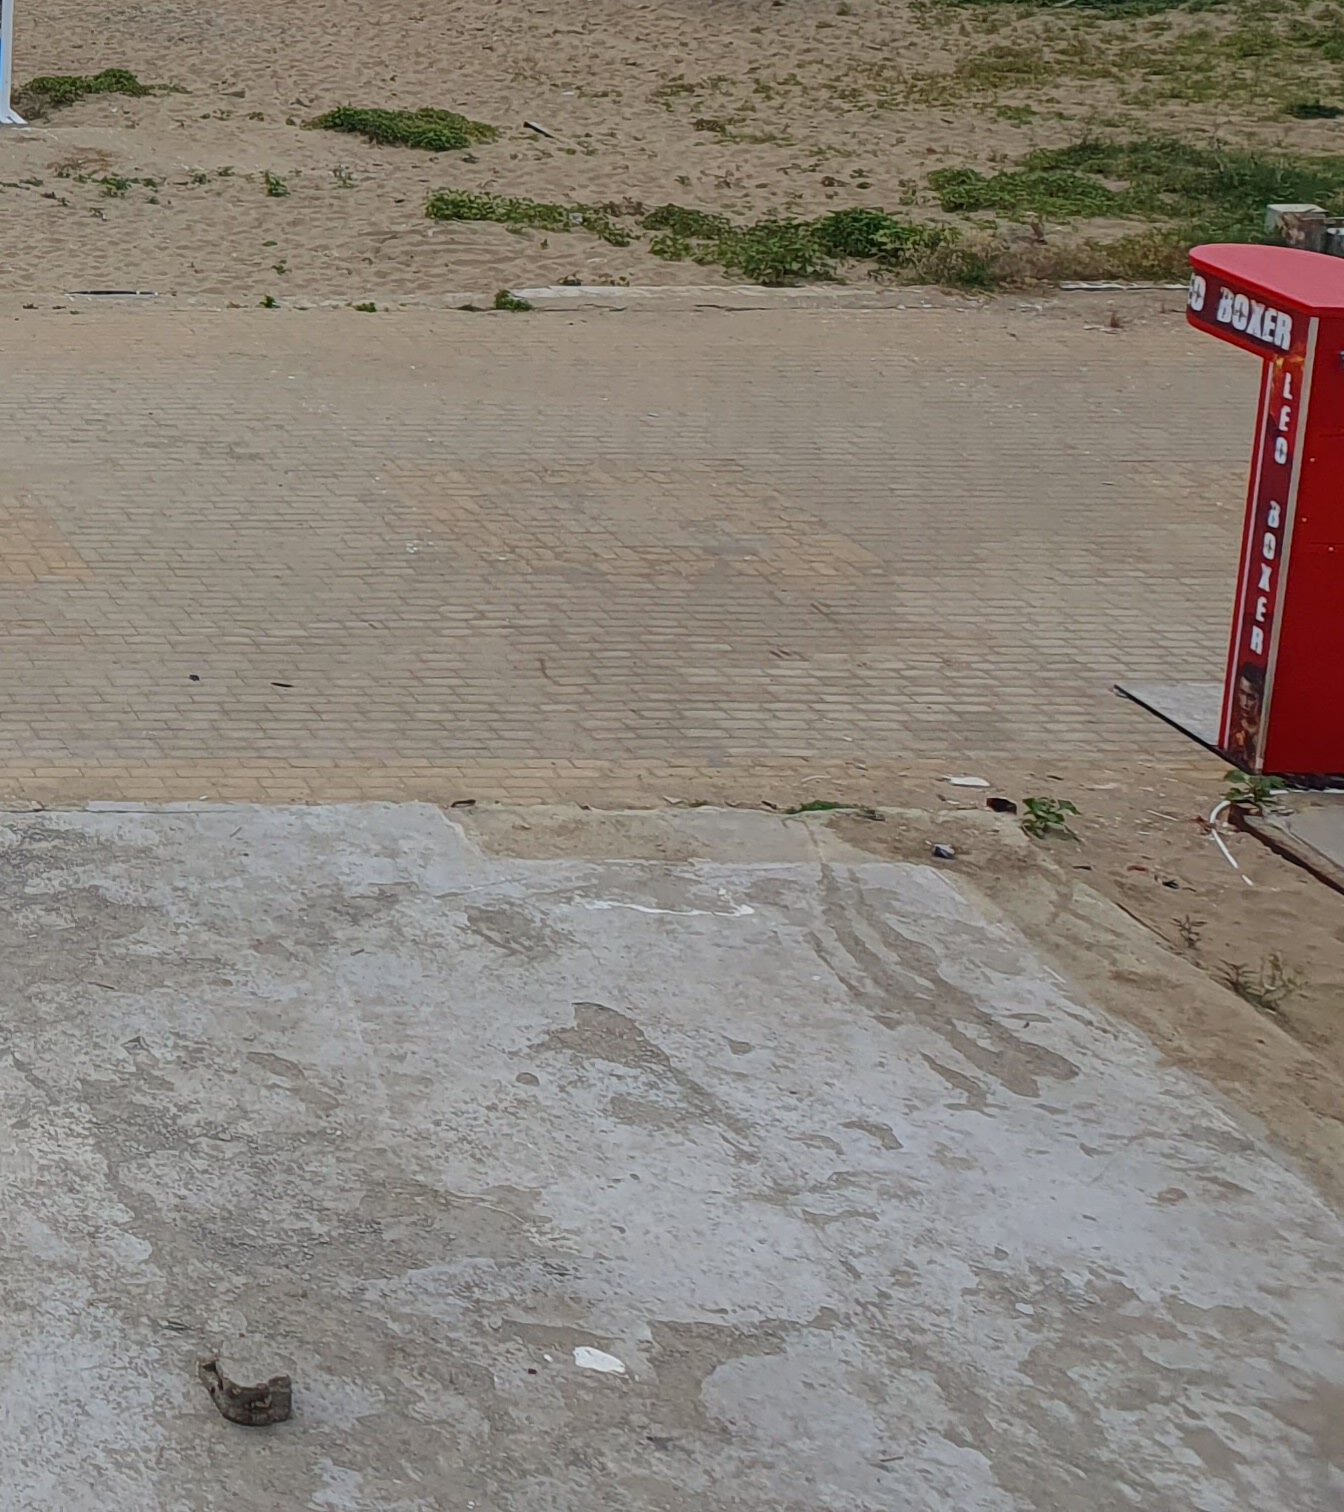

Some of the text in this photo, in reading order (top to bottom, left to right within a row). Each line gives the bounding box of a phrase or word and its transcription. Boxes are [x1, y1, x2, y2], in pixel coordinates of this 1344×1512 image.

[1216, 286, 1293, 351] BOXER
[1273, 372, 1293, 465] LEO
[1249, 500, 1281, 655] BOXER
